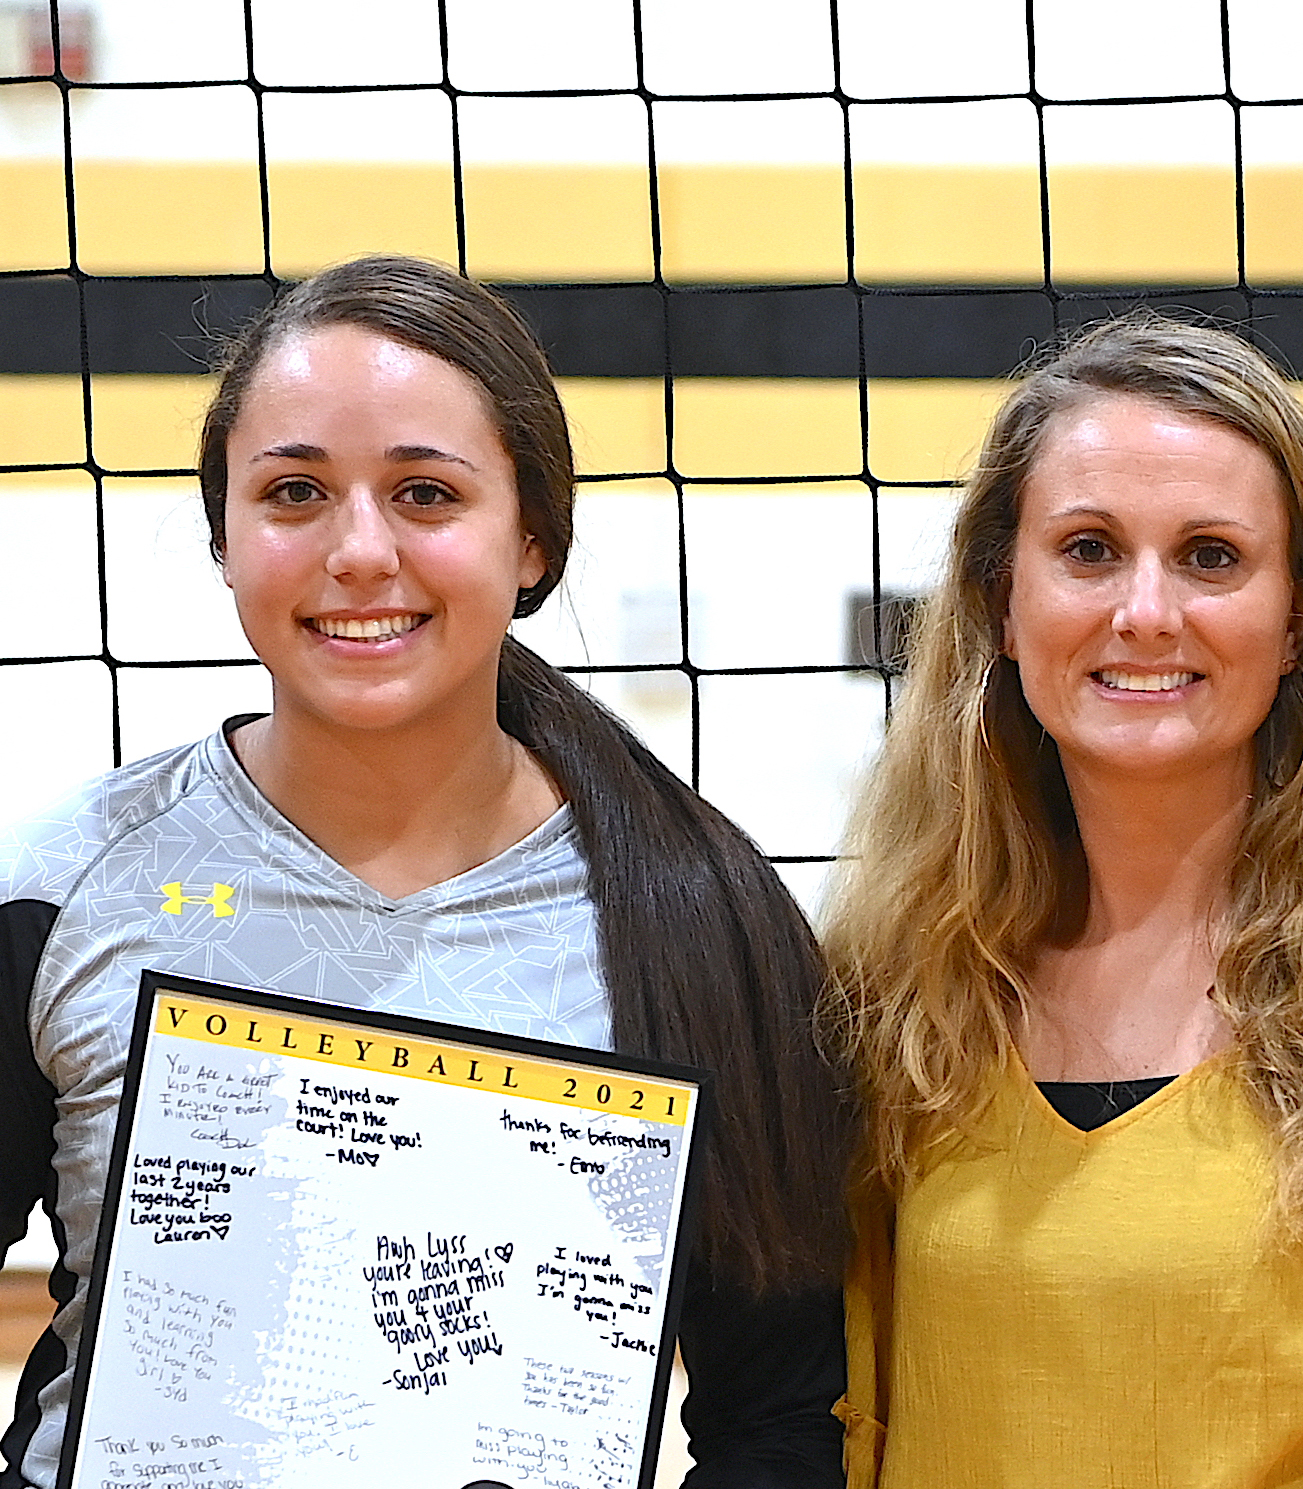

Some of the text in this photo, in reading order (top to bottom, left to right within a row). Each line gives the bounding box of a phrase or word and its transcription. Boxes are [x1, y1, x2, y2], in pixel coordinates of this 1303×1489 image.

[166, 1006, 675, 1117] VOLLEYBALL 2021
[159, 1093, 172, 1104] I
[300, 1078, 400, 1106] I enjoyed our
[296, 1099, 388, 1127] time on the
[296, 1119, 422, 1151] court! Love you!
[560, 1122, 581, 1140] for
[530, 1140, 556, 1155] me!
[134, 1153, 256, 1182] Loved playing our
[134, 1172, 165, 1187] last
[185, 1181, 231, 1197] years
[131, 1208, 232, 1232] Love you boo
[427, 1232, 466, 1264] Lyss
[554, 1247, 611, 1267] I loved
[407, 1280, 460, 1306] gonna
[466, 1270, 504, 1294] miss
[537, 1262, 653, 1299] playing with you
[537, 1283, 565, 1298] I'm
[123, 1271, 132, 1281] I
[216, 1299, 237, 1317] fun
[126, 1304, 150, 1324] and
[374, 1309, 407, 1336] you
[433, 1296, 473, 1319] your
[185, 1343, 217, 1366] from
[94, 1436, 140, 1455] Thank
[498, 1427, 545, 1451] going
[551, 1438, 568, 1447] to
[209, 1458, 223, 1471] I
[507, 1445, 568, 1471] playing
